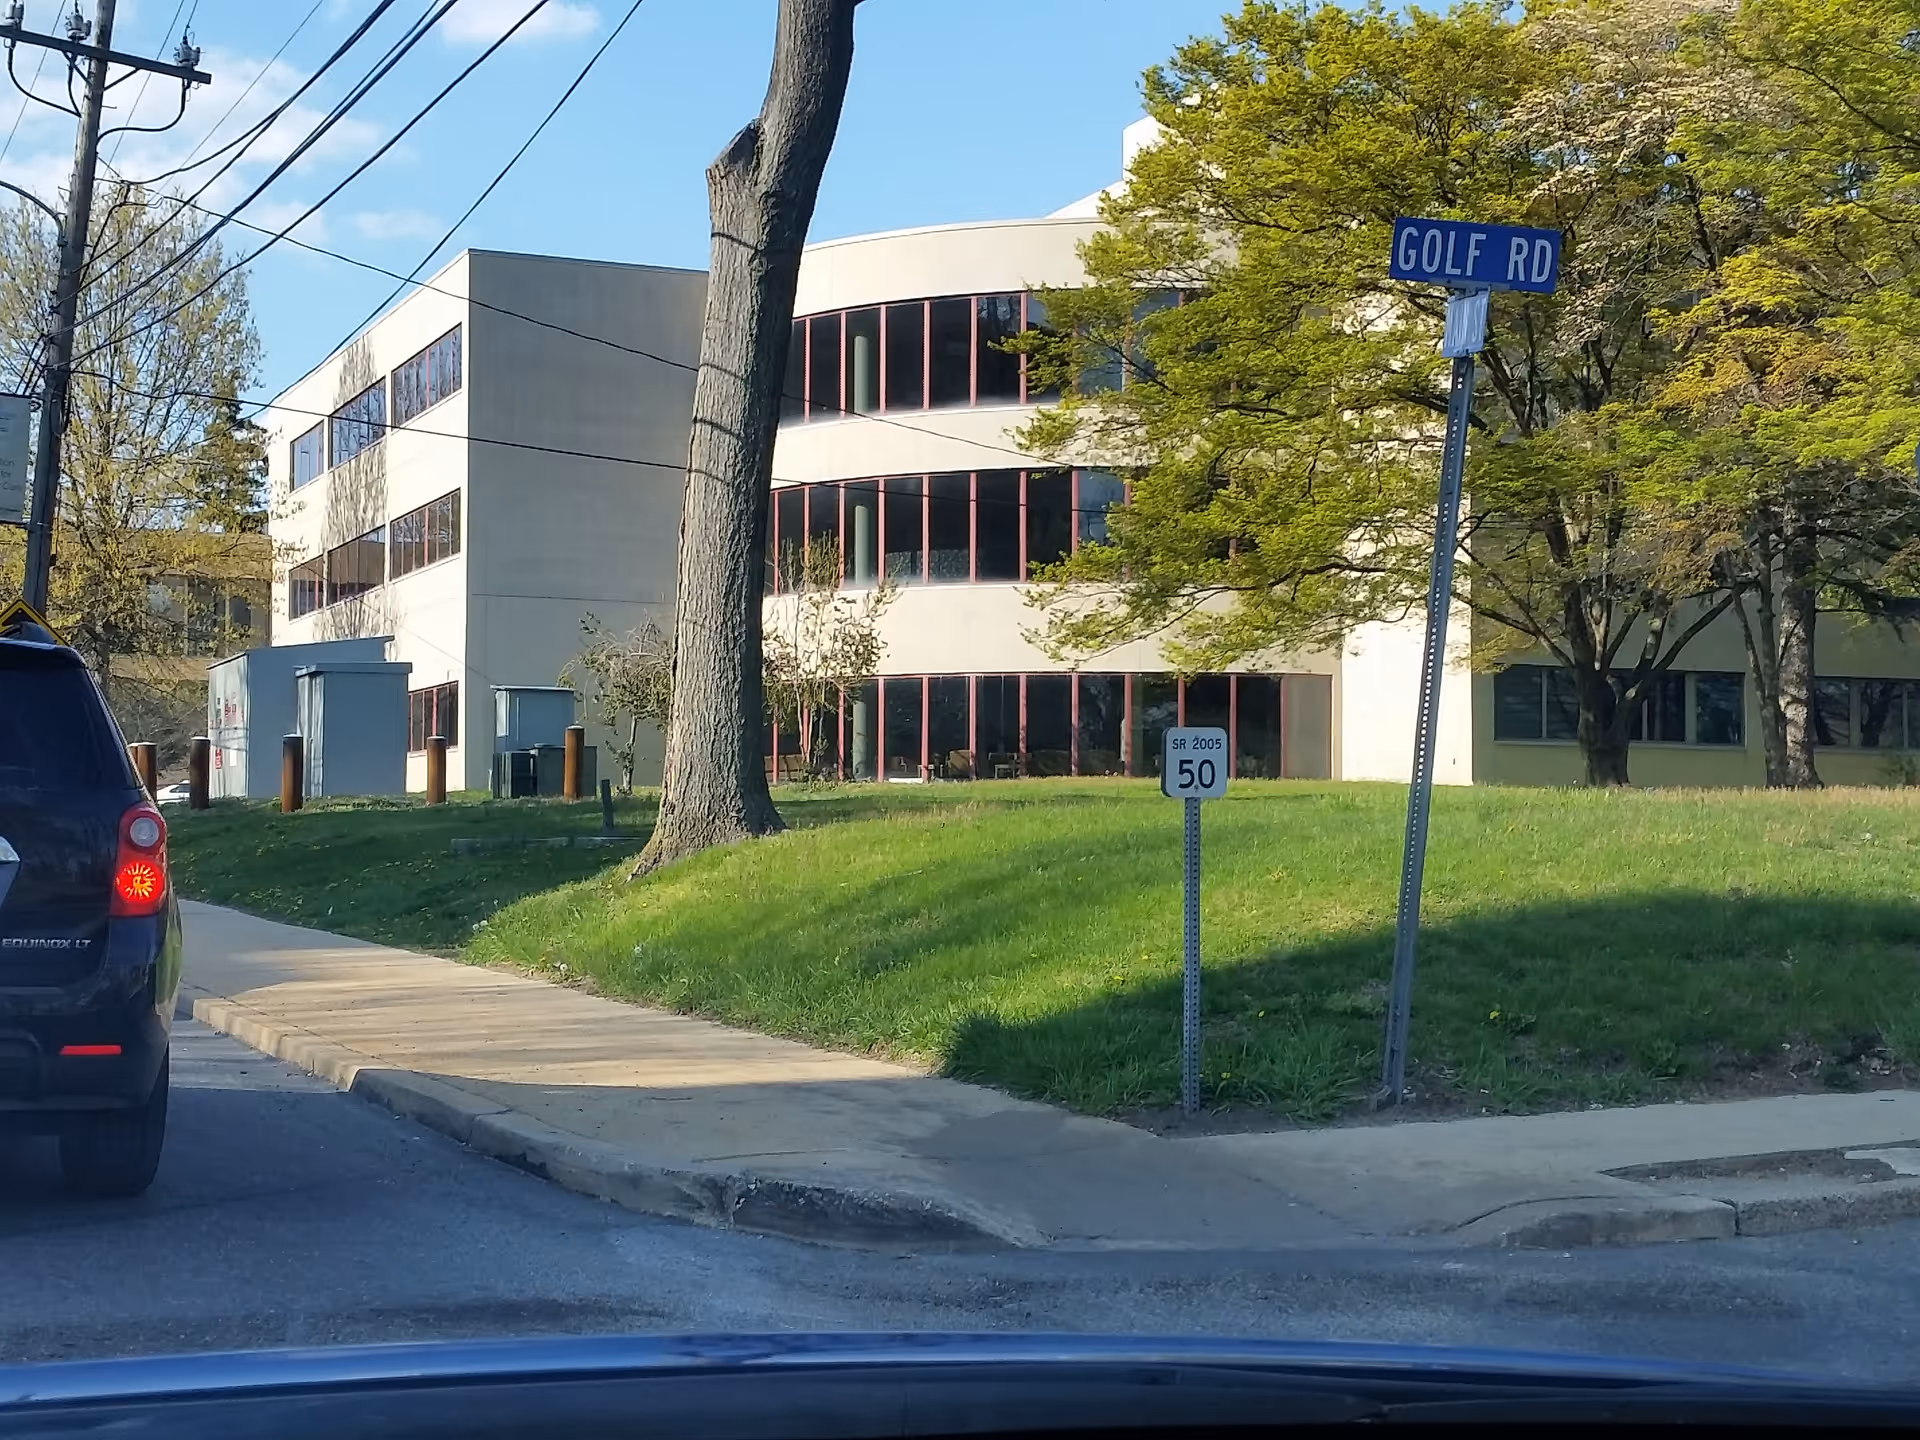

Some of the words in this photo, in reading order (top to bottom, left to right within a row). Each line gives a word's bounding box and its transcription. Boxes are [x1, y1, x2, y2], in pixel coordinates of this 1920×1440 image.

[1398, 226, 1487, 277] GOLF
[1507, 236, 1553, 283] RD
[1172, 738, 1187, 750] SR
[1192, 738, 1222, 750] 2005
[1178, 759, 1216, 789] 50
[1, 938, 71, 949] EQUINOX
[75, 939, 92, 949] LT
